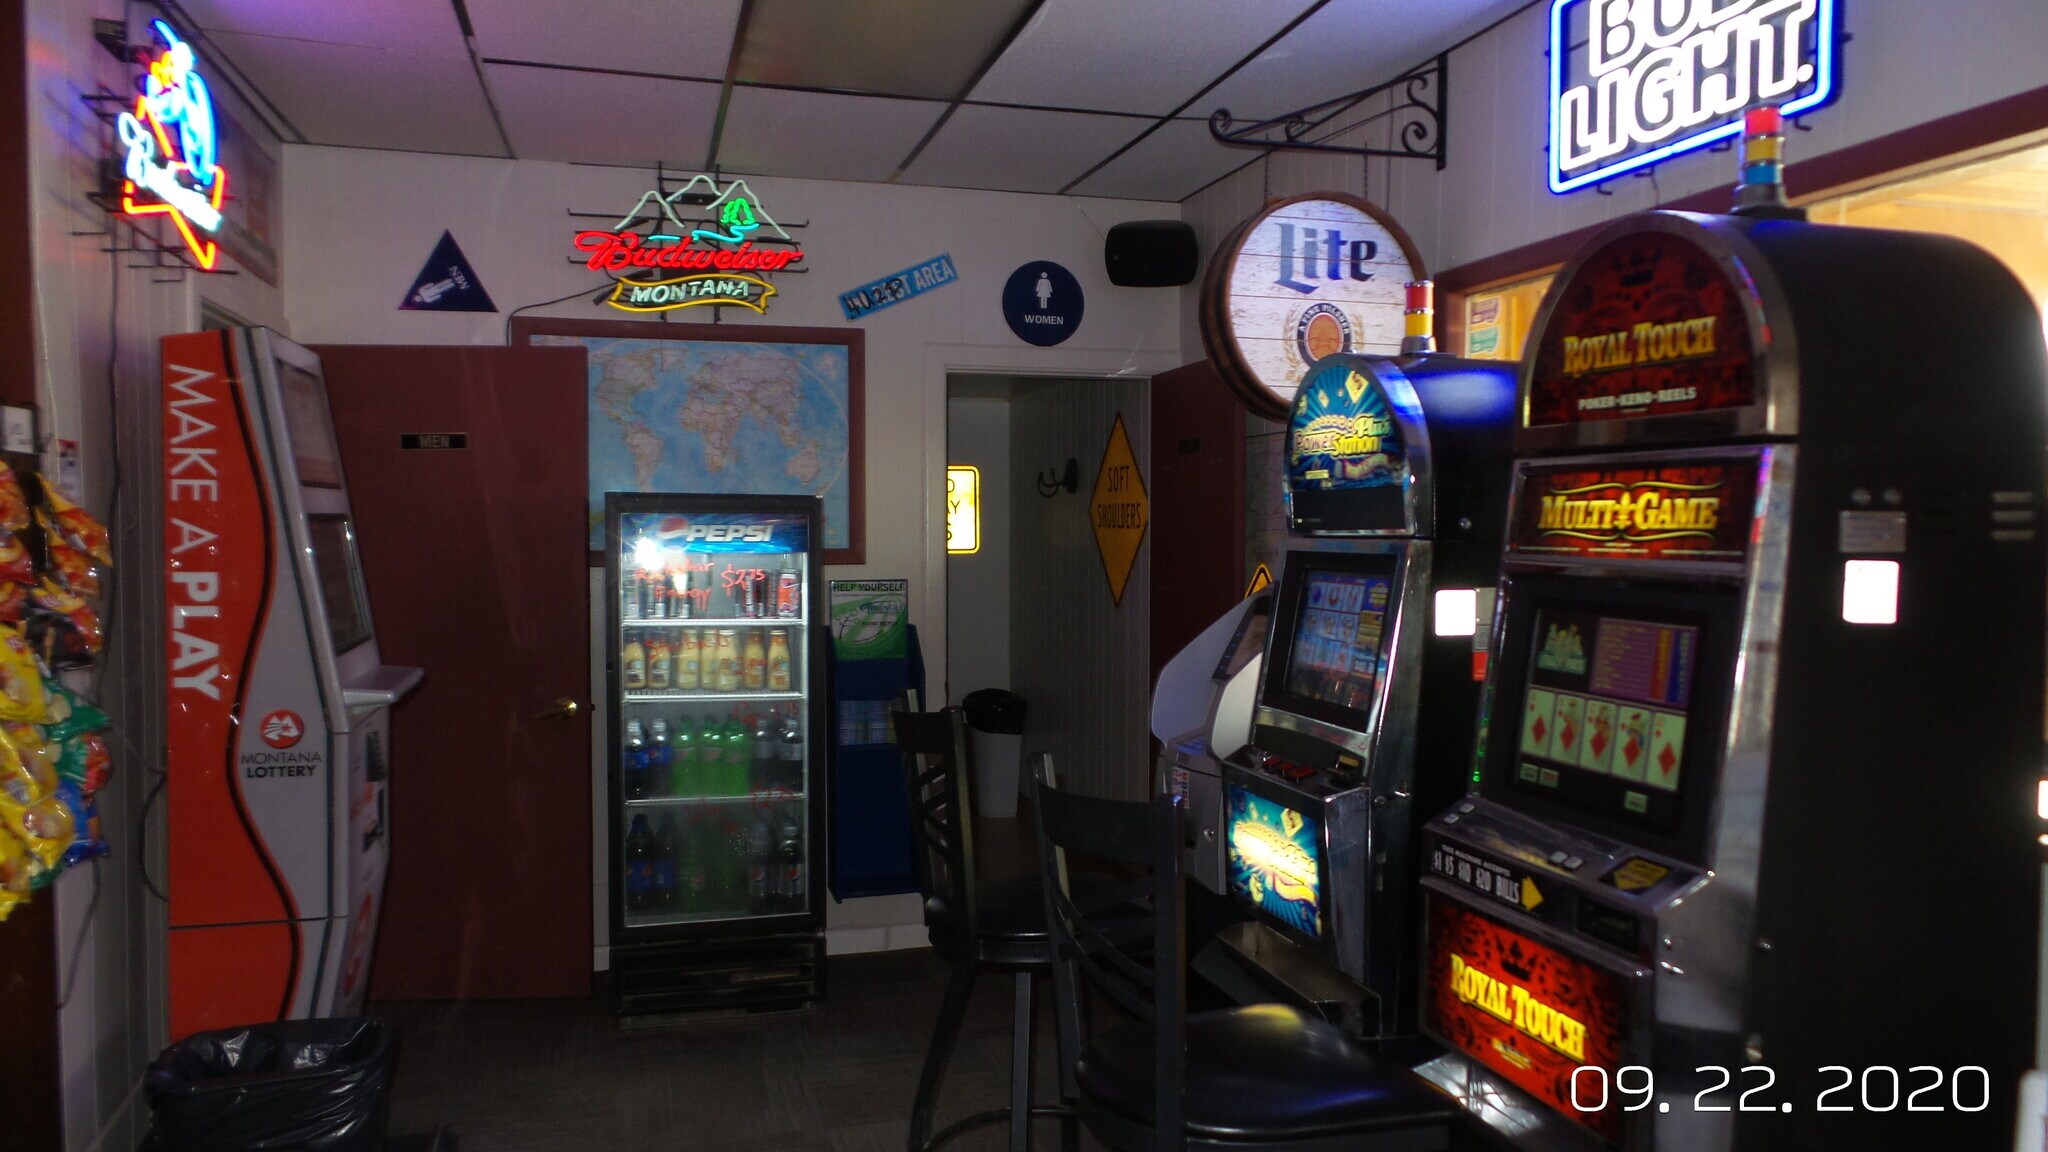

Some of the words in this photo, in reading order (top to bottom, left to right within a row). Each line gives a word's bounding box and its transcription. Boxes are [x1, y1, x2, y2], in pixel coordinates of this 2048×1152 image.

[1589, 0, 1763, 77] BU
[574, 230, 805, 271] Budweiser
[1273, 223, 1378, 295] Lite
[448, 265, 471, 290] MEN
[629, 279, 750, 303] MONTANA
[913, 259, 955, 291] AREA
[1024, 313, 1065, 326] WOMEN
[1563, 331, 1632, 378] ROYAL
[1633, 315, 1718, 363] TOUCH
[169, 363, 220, 503] MAKE
[420, 435, 450, 448] MEN
[1108, 465, 1130, 493] SOFT
[1098, 502, 1142, 529] SHOULDERS
[1537, 495, 1617, 530] MULTI
[1634, 491, 1720, 530] GAME
[170, 517, 220, 555] A
[686, 524, 774, 542] PEPSI
[833, 583, 857, 592] HELP
[858, 582, 906, 592] YOURSELF
[171, 571, 221, 701] PLAY
[241, 752, 322, 764] MONTANA
[247, 765, 317, 778] LOTTERY
[1433, 850, 1442, 872] $1
[1444, 855, 1455, 876] $5
[1457, 859, 1472, 884] $10
[1475, 866, 1492, 892] $20
[1495, 874, 1520, 904] BILLS
[1450, 952, 1513, 1025] ROYAL
[1511, 984, 1587, 1064] TOUCH
